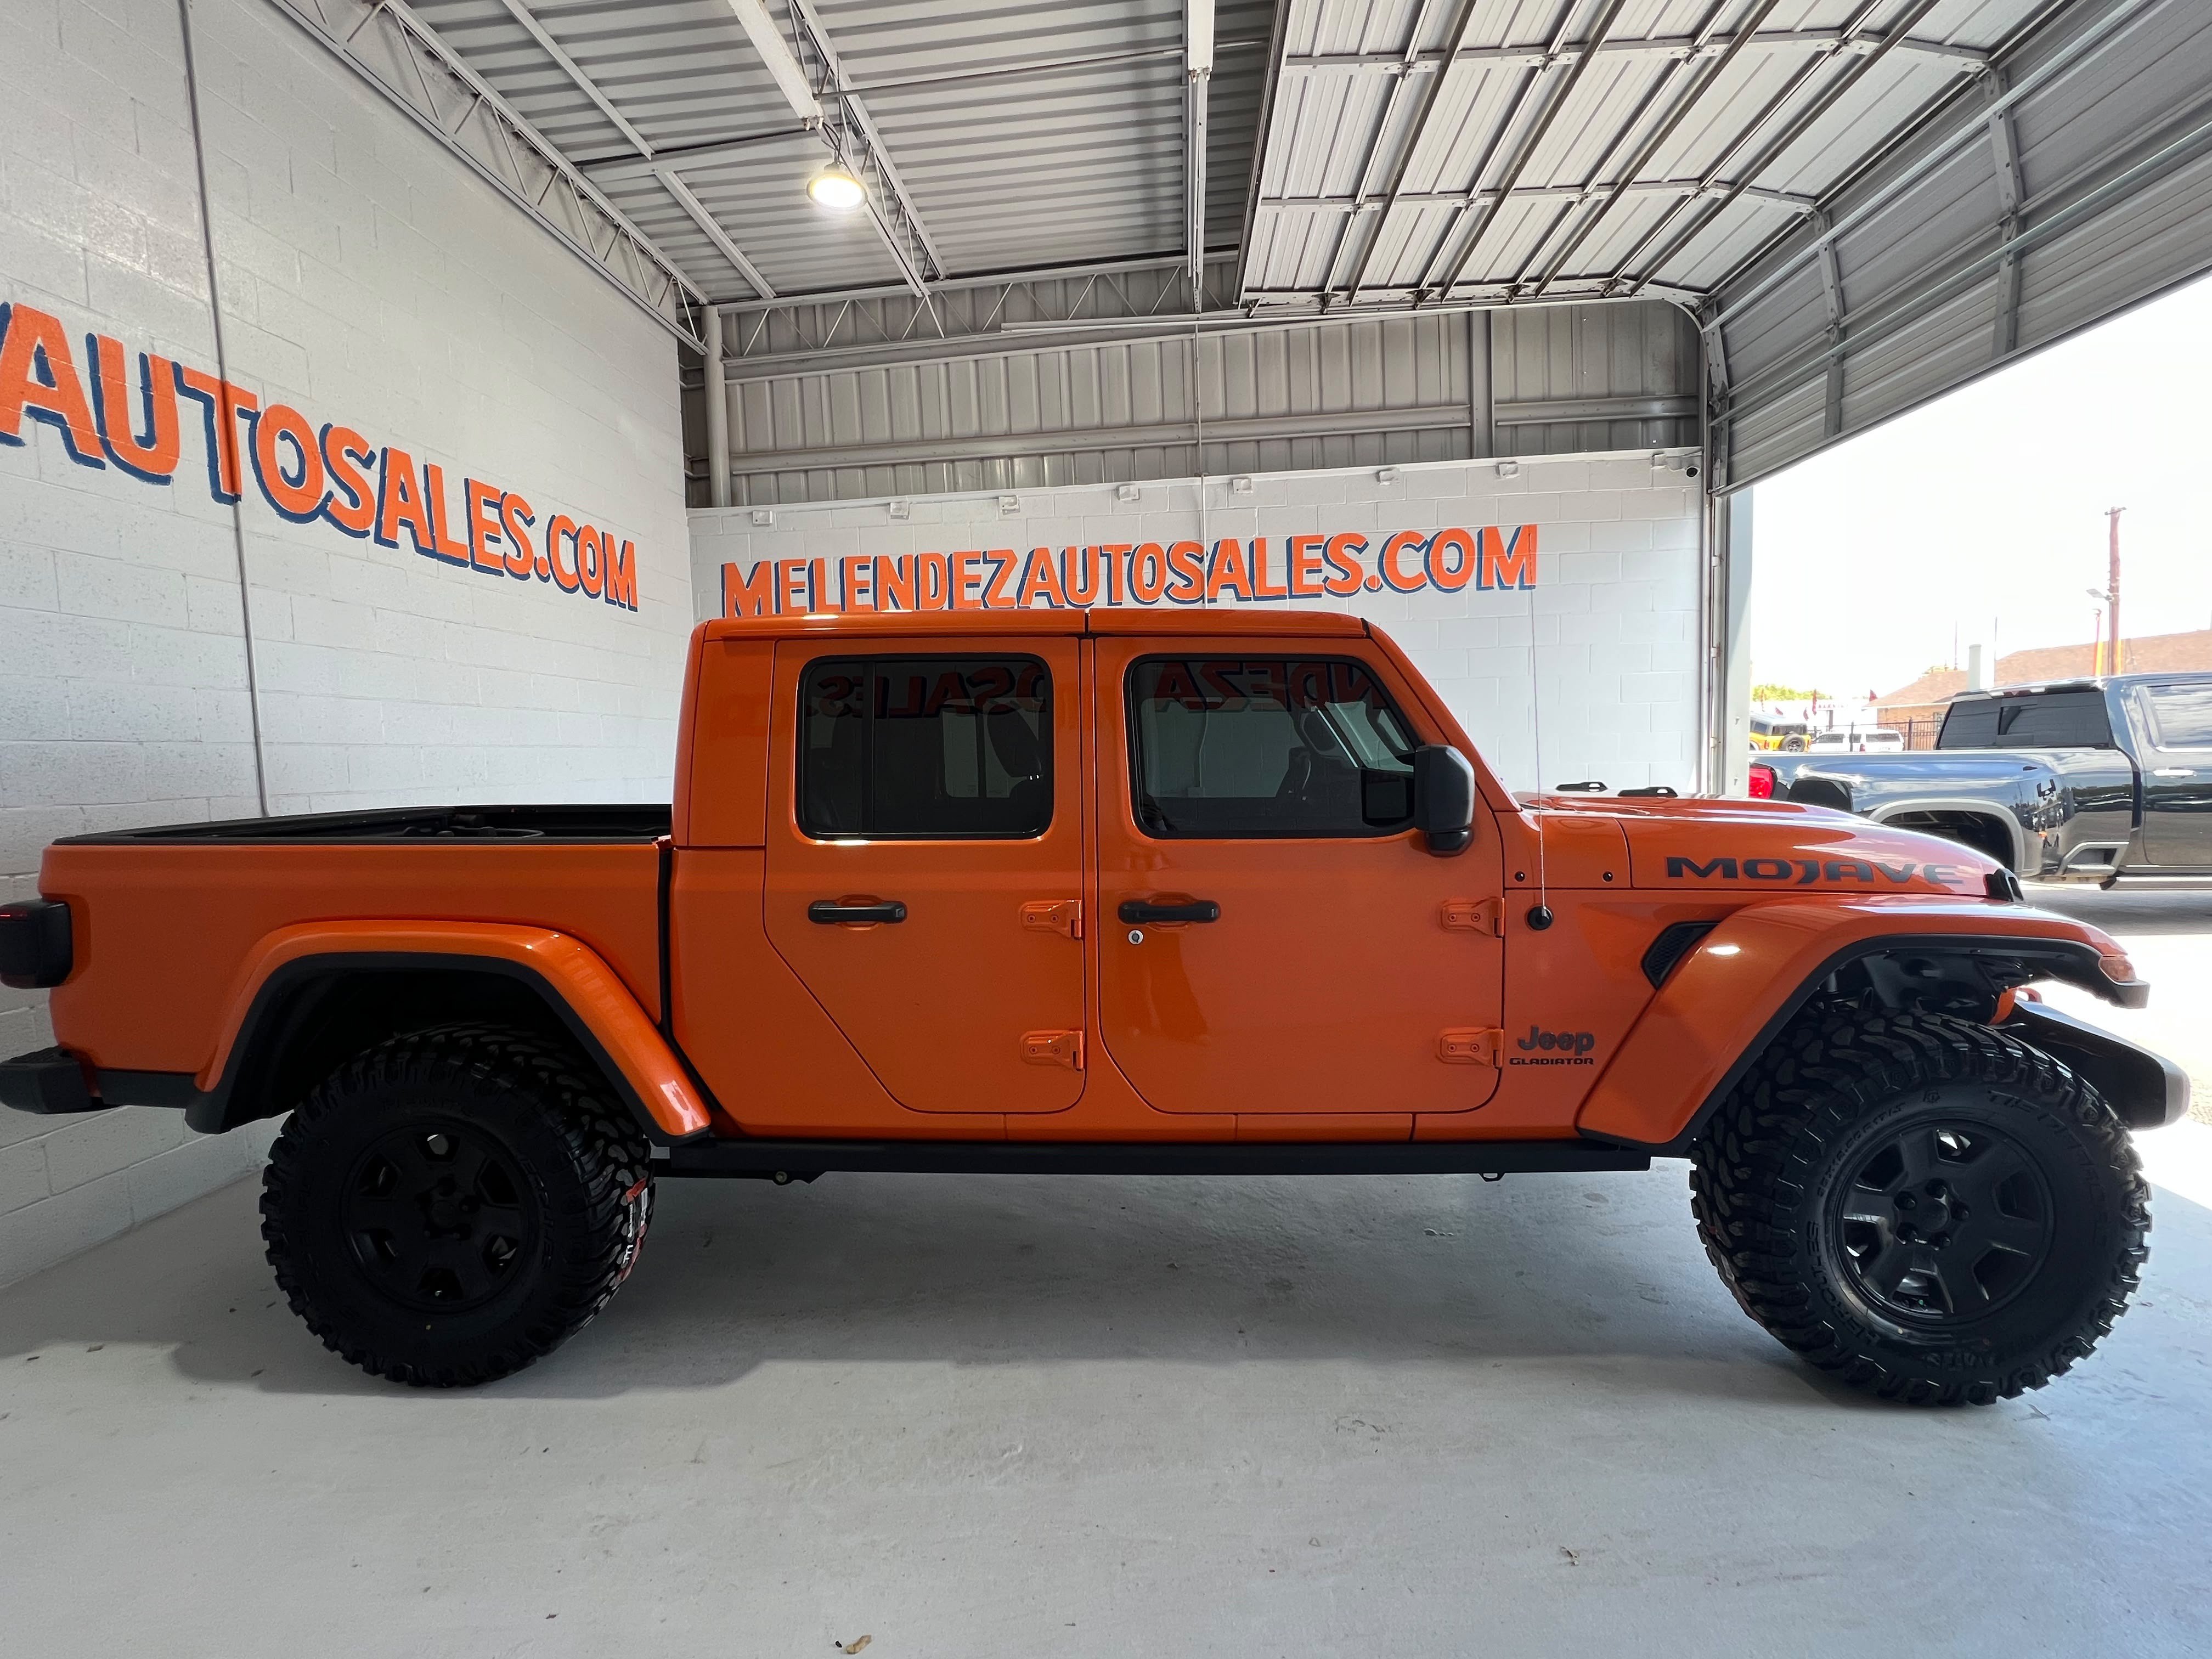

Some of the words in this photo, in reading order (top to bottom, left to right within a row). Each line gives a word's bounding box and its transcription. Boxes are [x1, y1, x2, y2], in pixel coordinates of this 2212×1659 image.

[0, 301, 639, 613] AUTOSALES.COM
[721, 524, 1537, 618] MELENDEZAUTOSALES.COM
[1666, 856, 1964, 884] MOJAVE
[1517, 1025, 1594, 1056] Jeep
